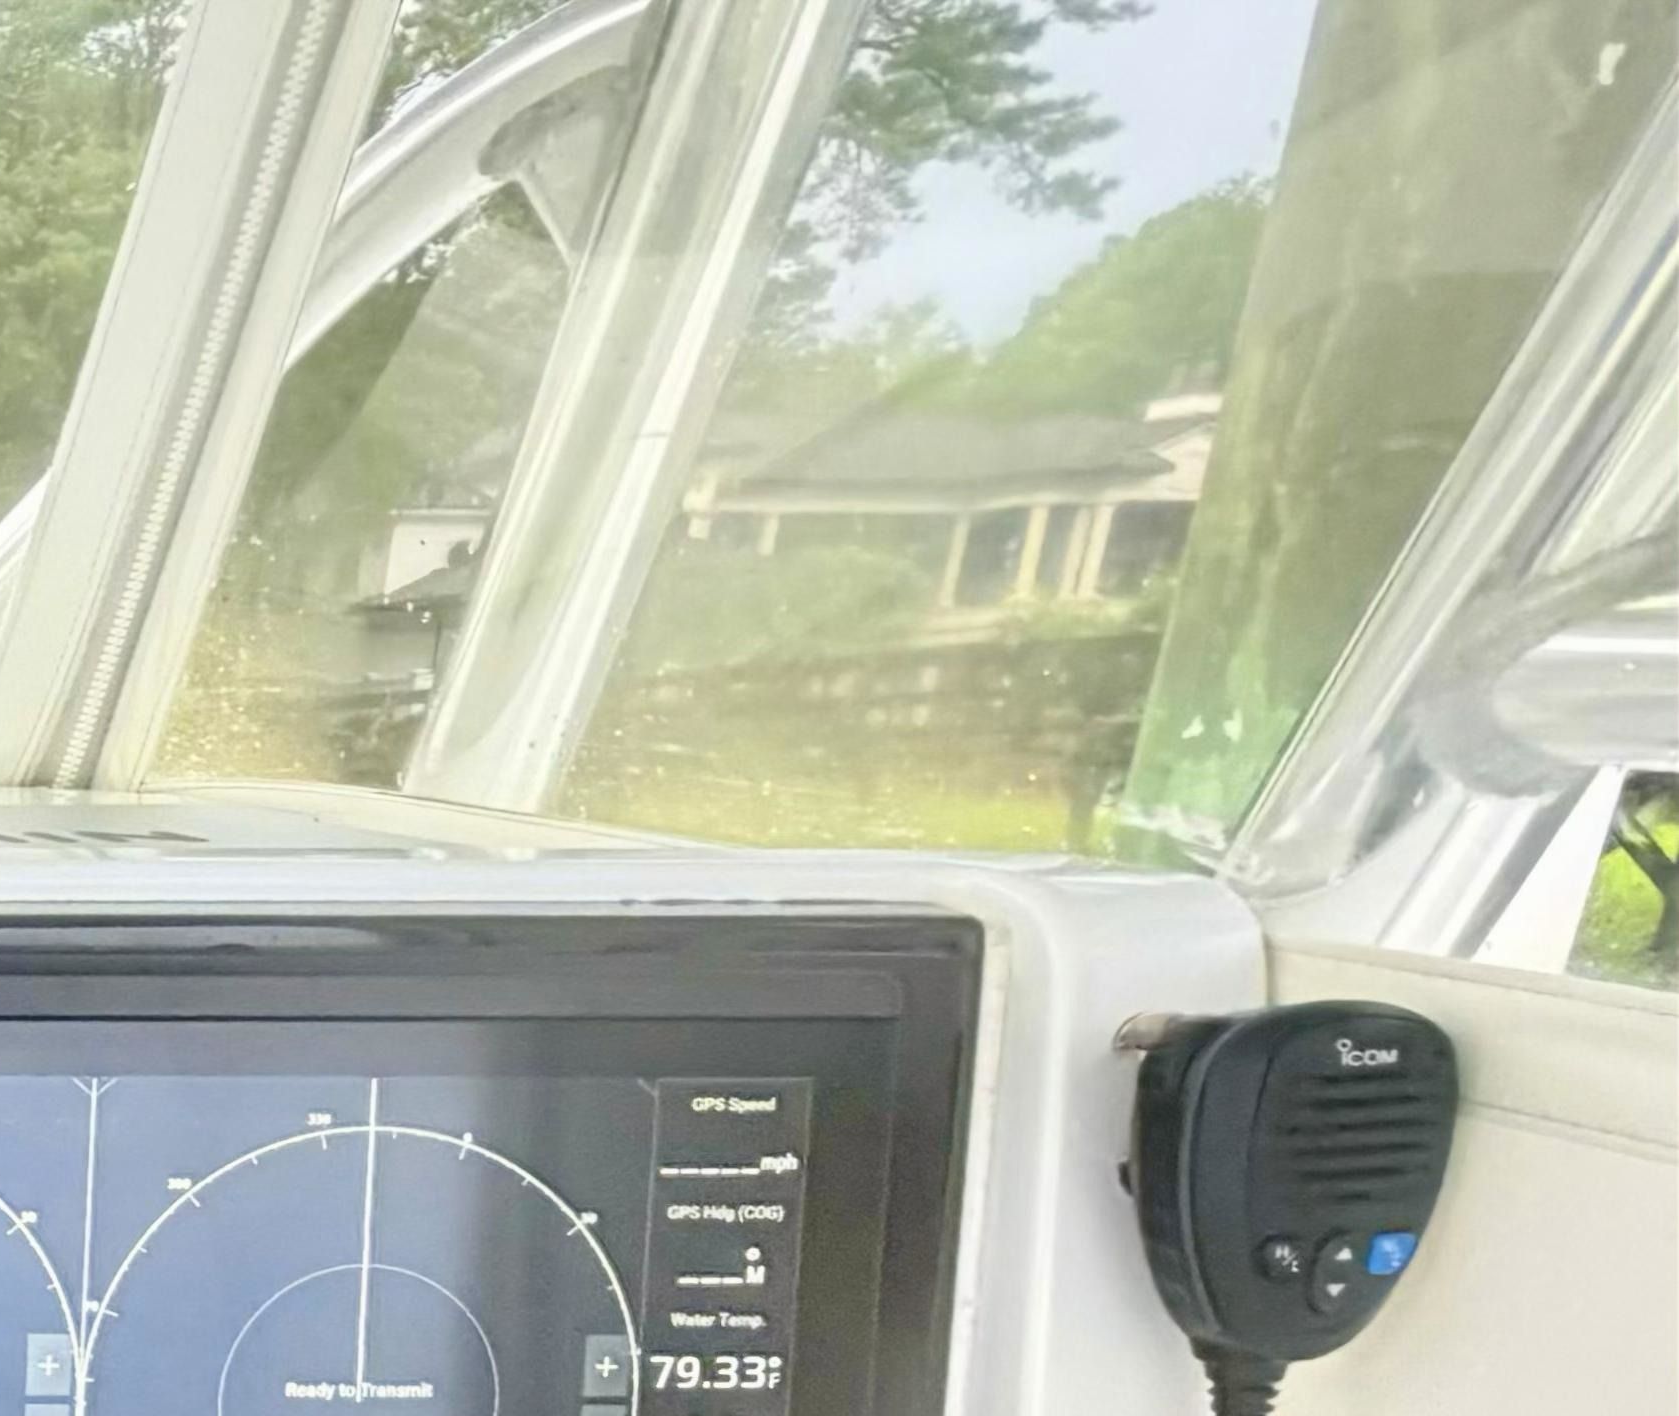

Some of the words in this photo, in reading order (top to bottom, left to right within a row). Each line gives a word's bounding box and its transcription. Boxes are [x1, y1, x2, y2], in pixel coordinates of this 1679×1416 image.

[691, 1097, 726, 1111] GPS
[728, 1097, 777, 1113] Speed
[759, 1152, 799, 1175] mph
[666, 1205, 701, 1220] GPS
[702, 1205, 736, 1222] Hdg
[738, 1205, 785, 1222] (COG)
[670, 1312, 716, 1327] Water
[284, 1381, 335, 1401] Ready
[338, 1382, 356, 1399] to
[361, 1381, 434, 1398] Transmit
